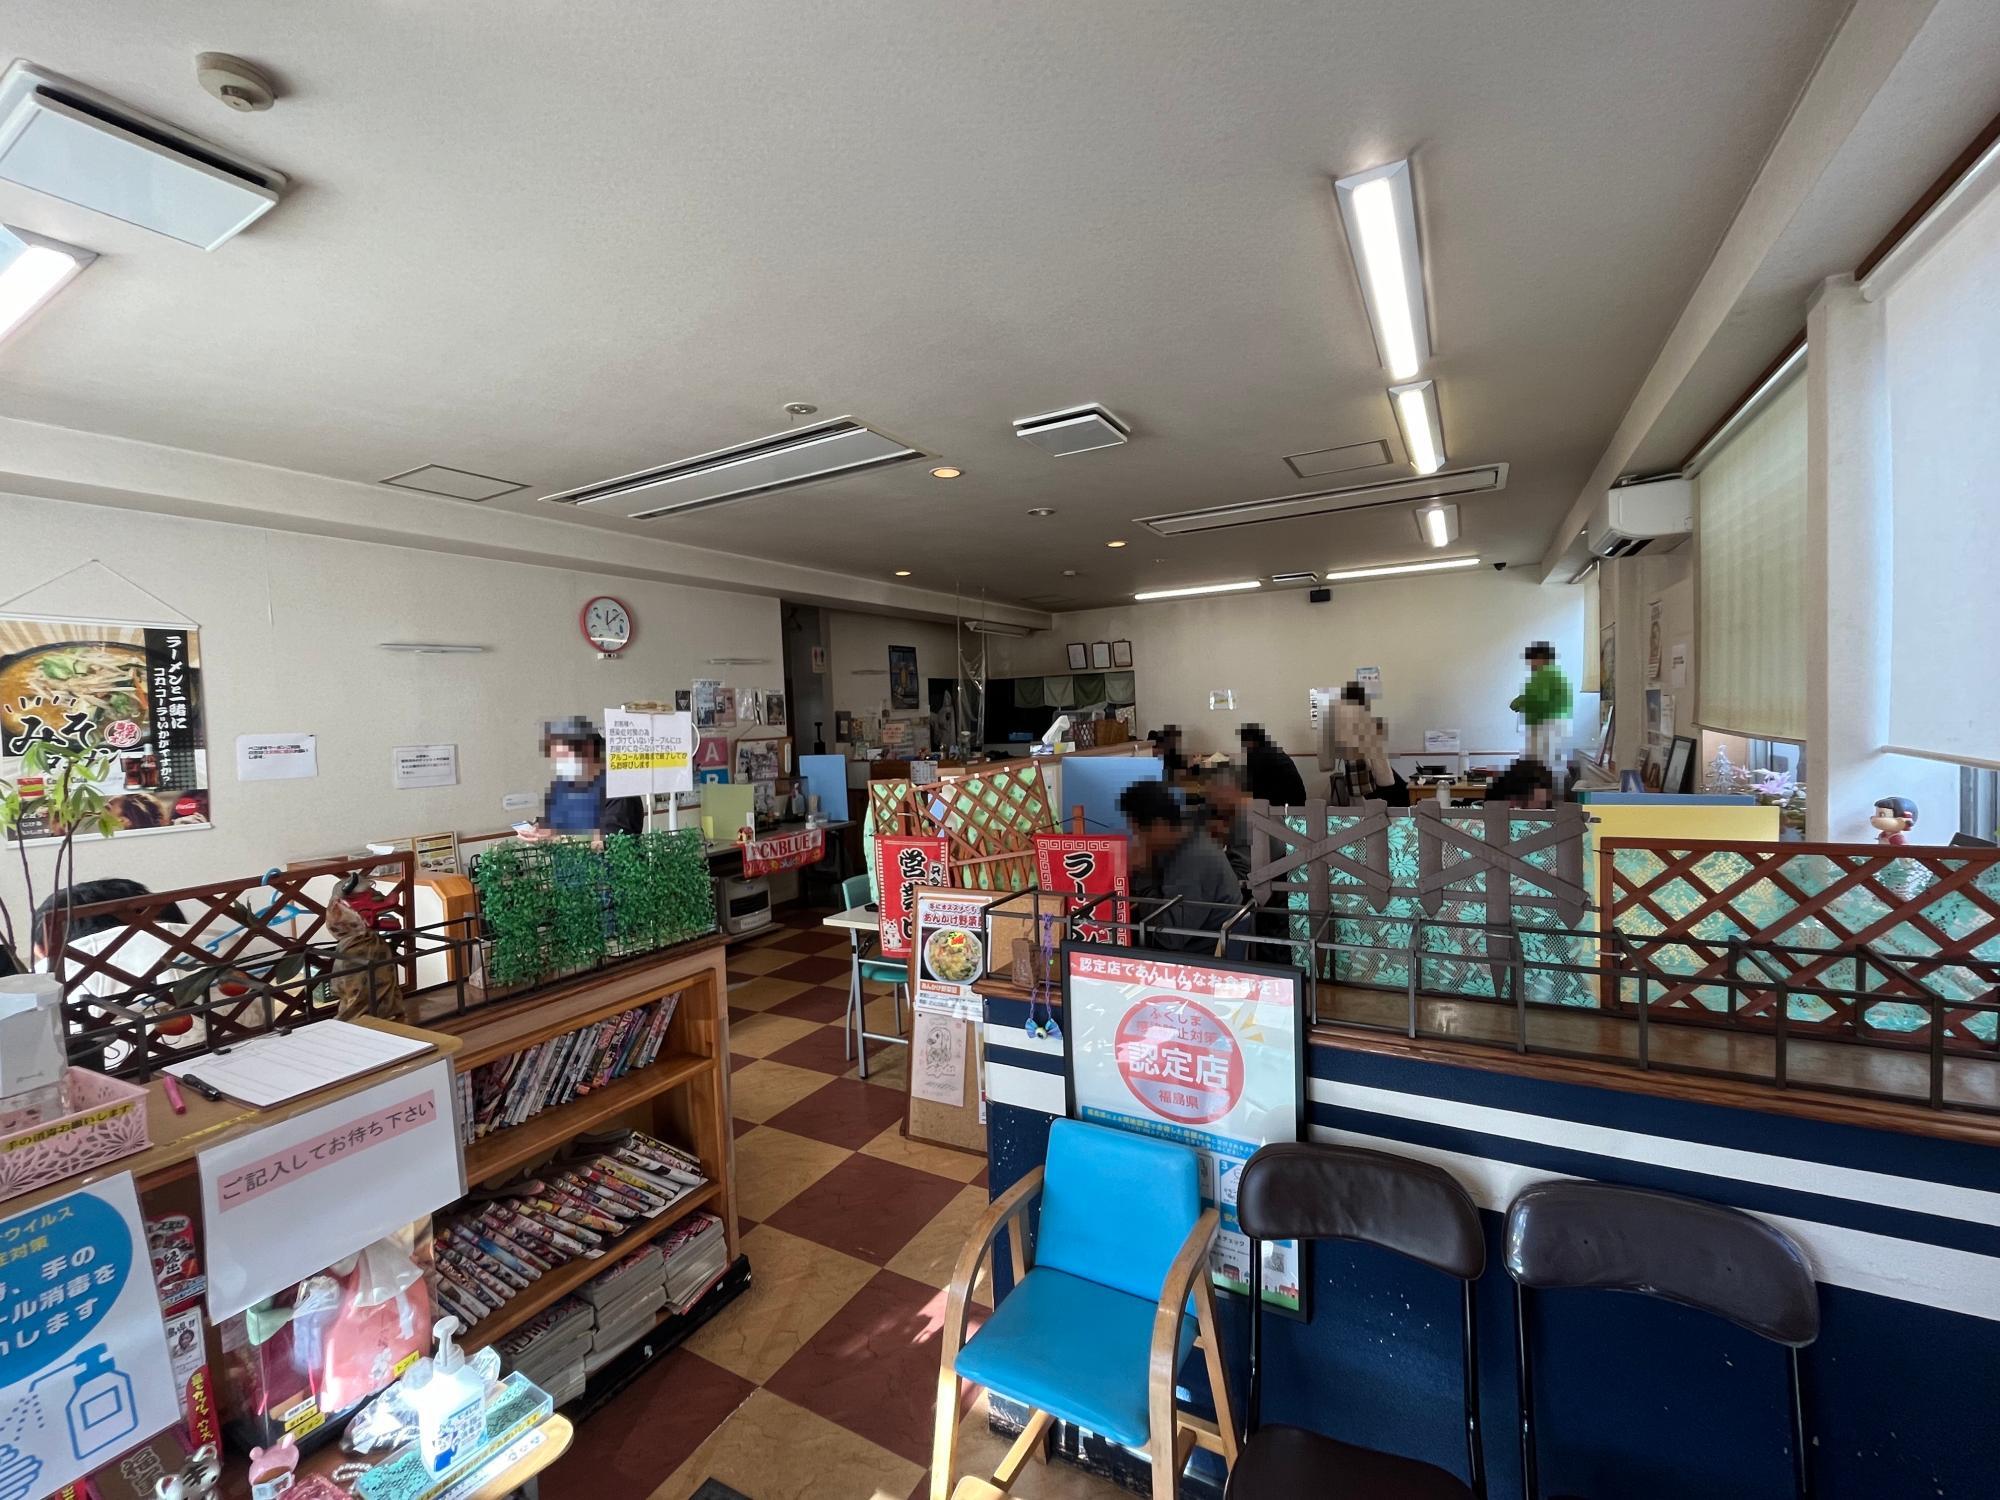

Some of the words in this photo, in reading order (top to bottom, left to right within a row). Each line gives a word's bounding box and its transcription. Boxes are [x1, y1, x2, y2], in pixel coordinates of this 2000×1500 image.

[166, 635, 188, 729] ラーメンと一緒に
[704, 741, 720, 762] A
[1151, 1006, 1202, 1025] ふくしま
[1136, 1020, 1218, 1044] 感止対策
[1127, 1042, 1230, 1089] 認定店
[1158, 1089, 1200, 1110] 福島県
[223, 1100, 435, 1200] ご記入してお待ち下さい
[0, 1206, 75, 1242] ウイルス
